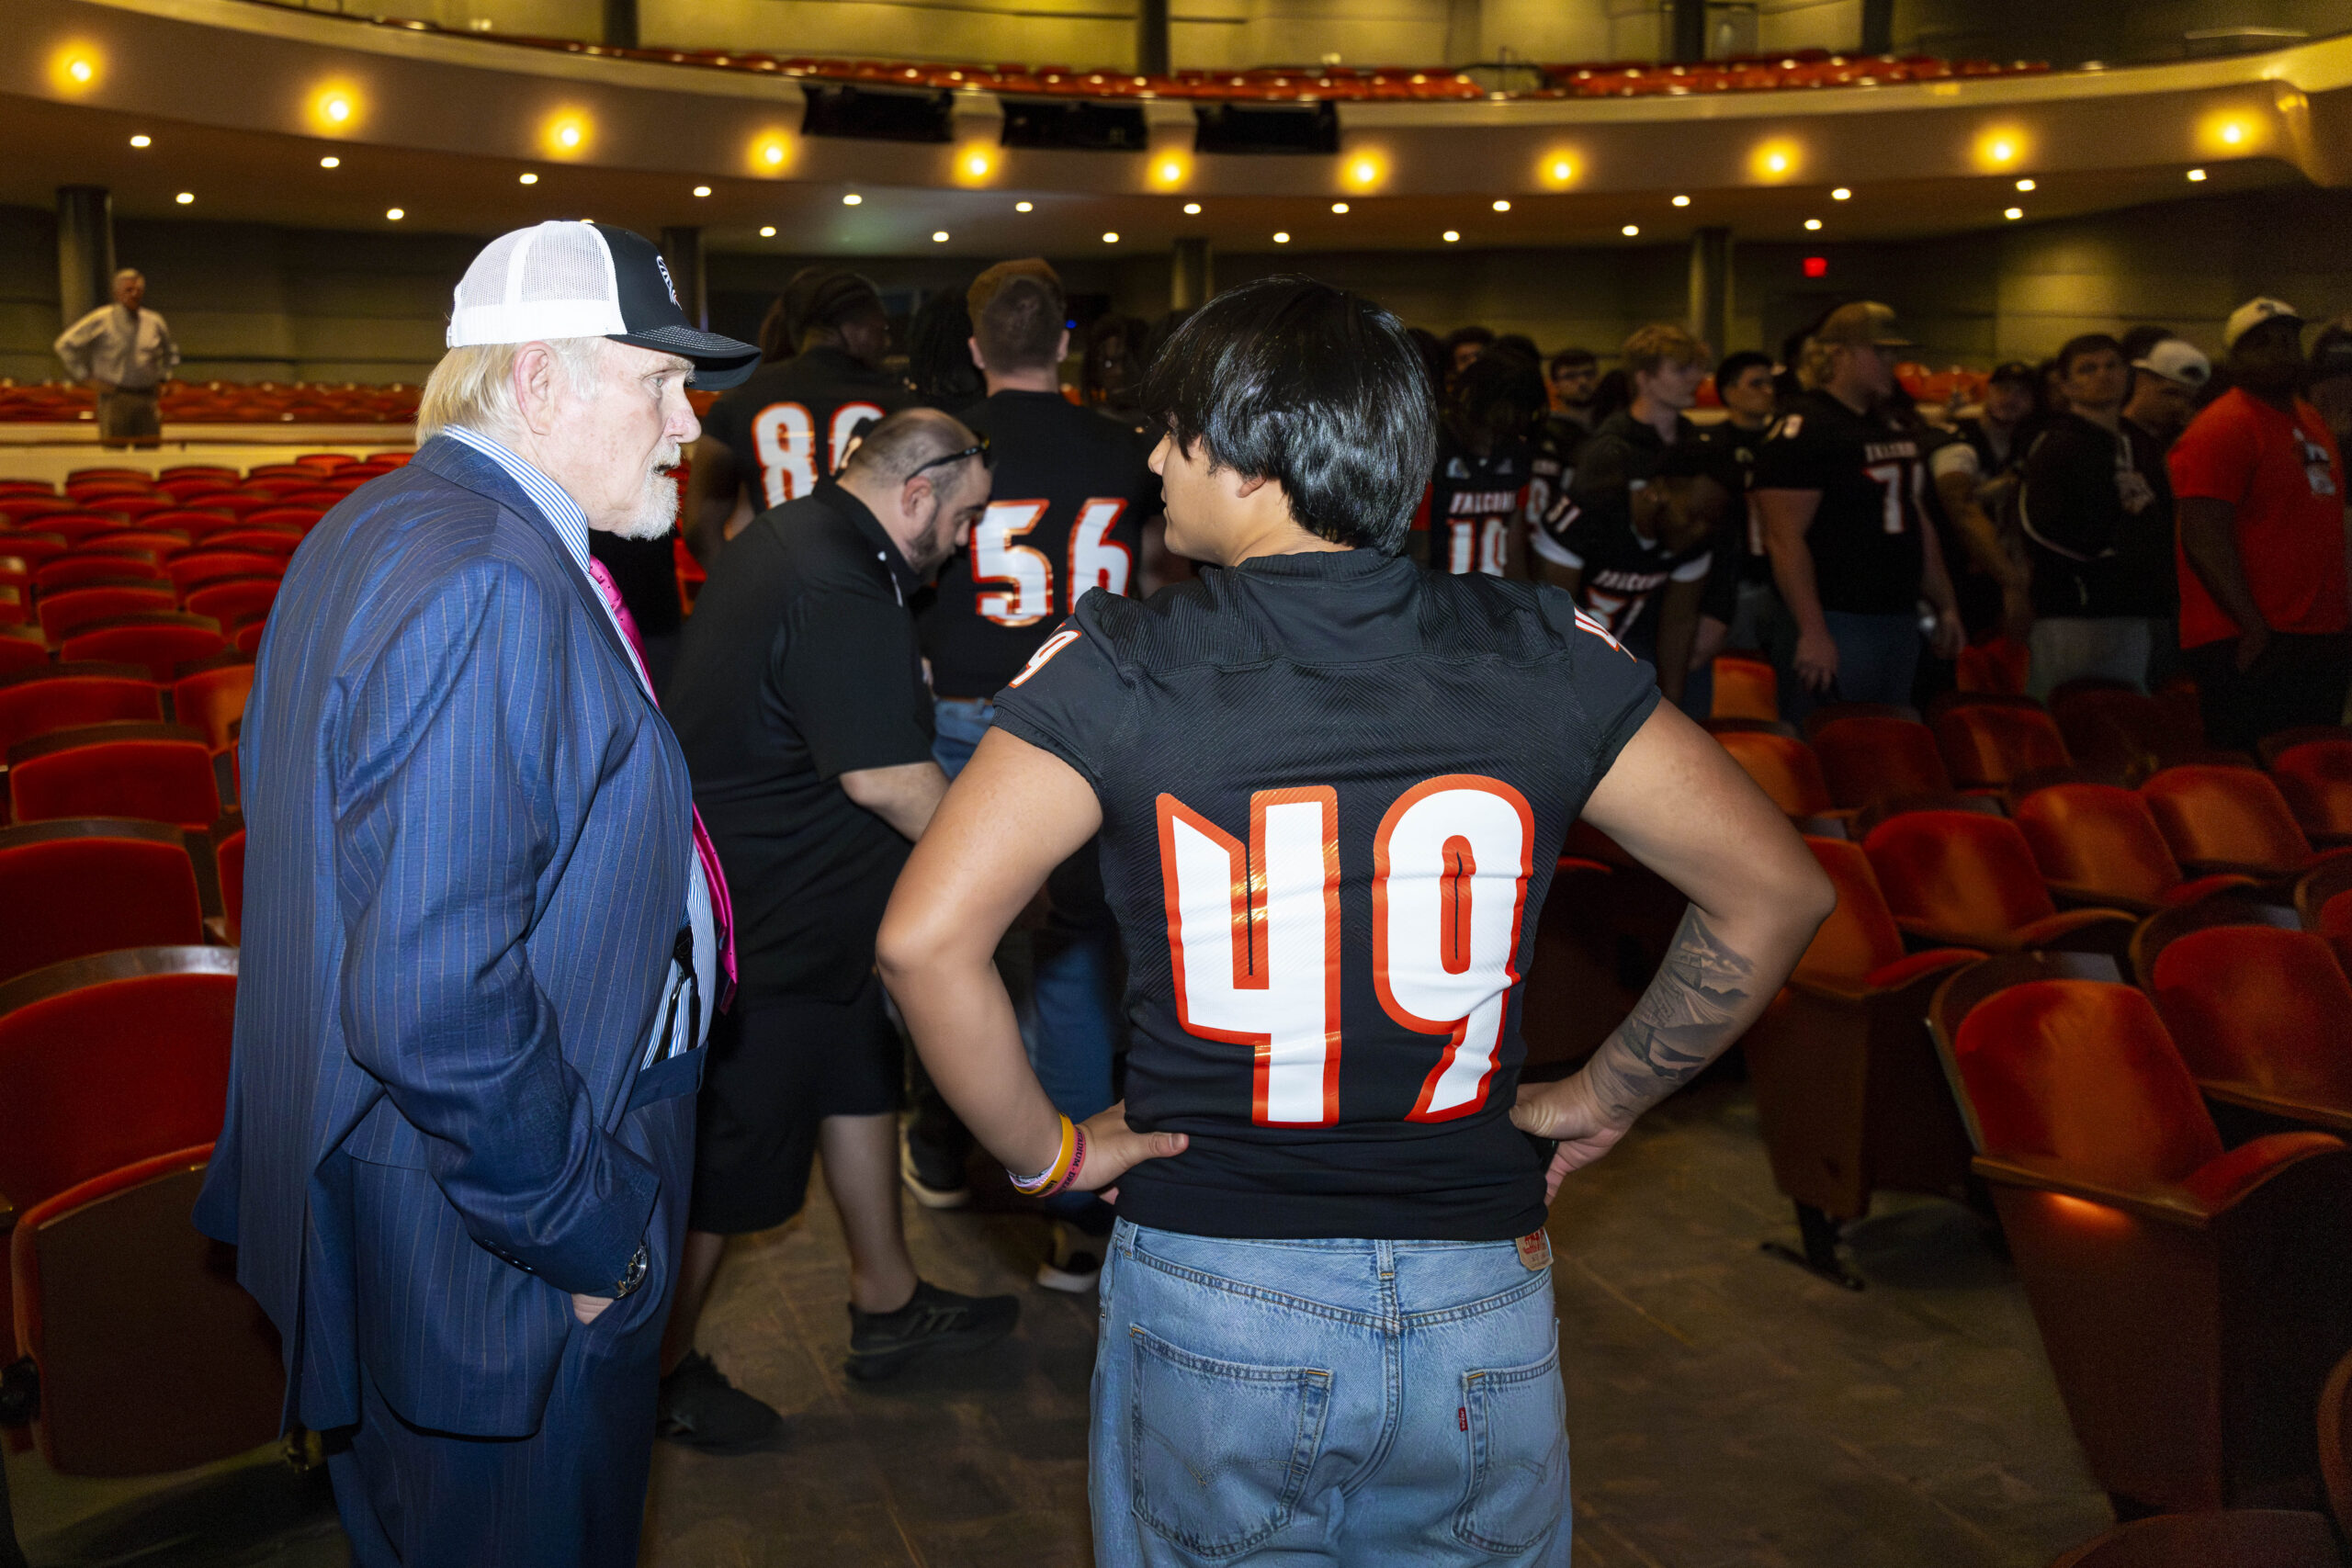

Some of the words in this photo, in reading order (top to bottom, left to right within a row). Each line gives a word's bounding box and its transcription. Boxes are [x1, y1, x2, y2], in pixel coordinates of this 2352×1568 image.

[971, 497, 1133, 627] 56
[1446, 517, 1508, 578] 10
[1009, 622, 1082, 689] 9
[1156, 773, 1535, 1129] 49
